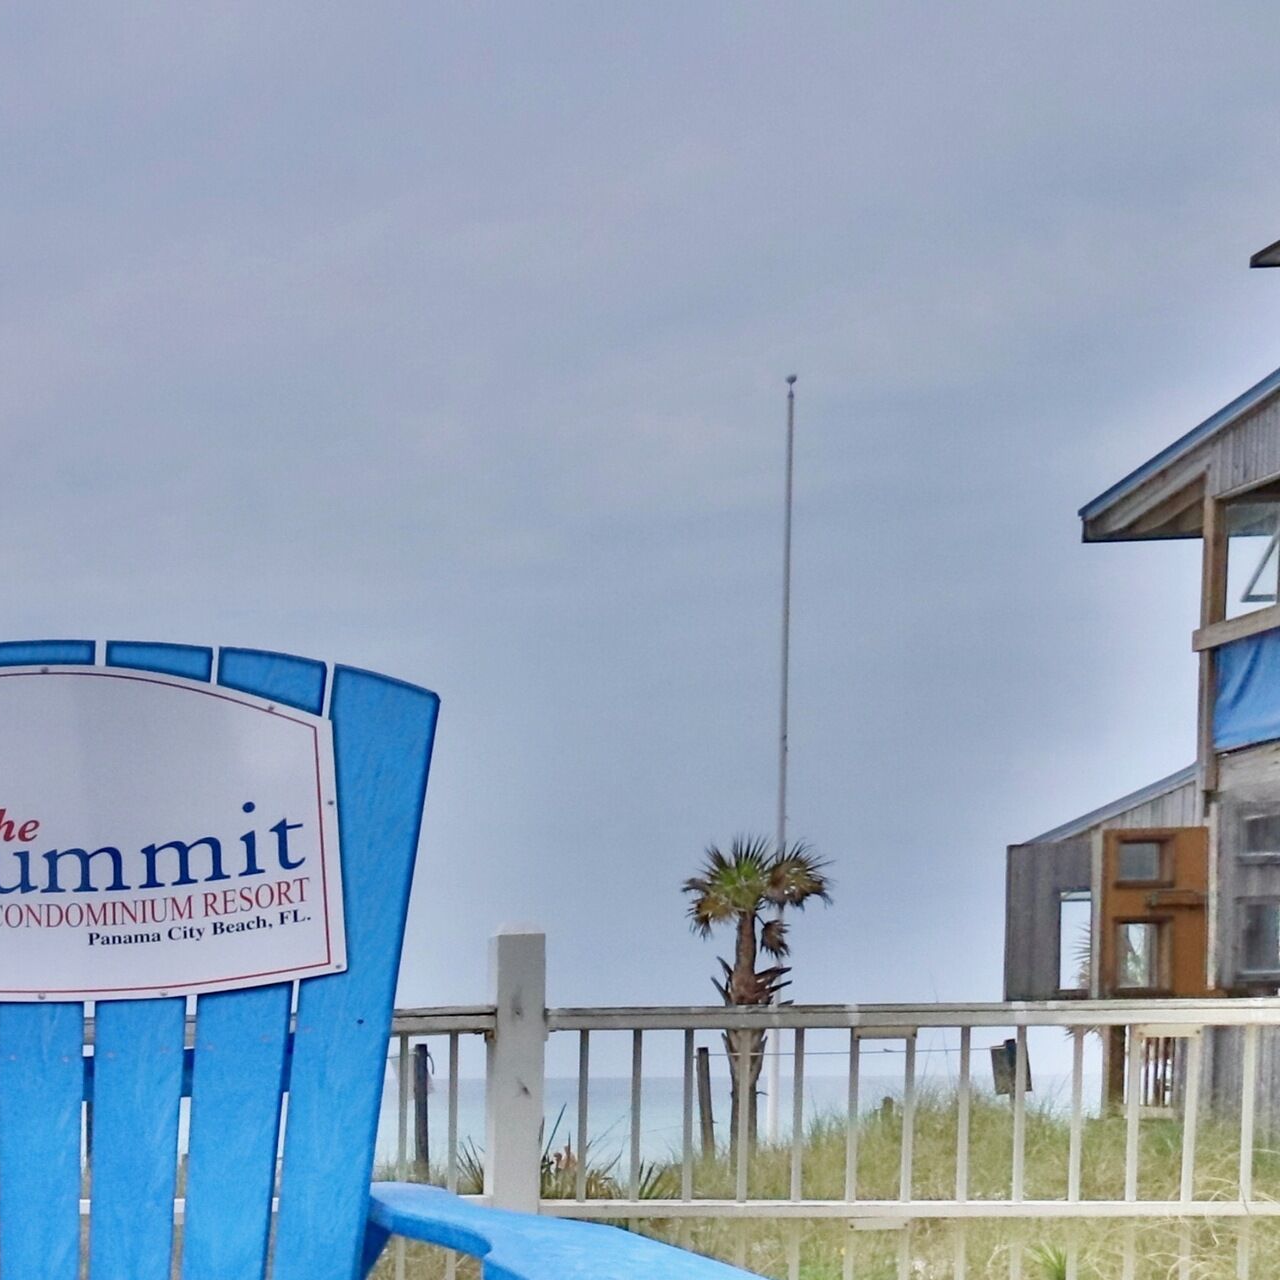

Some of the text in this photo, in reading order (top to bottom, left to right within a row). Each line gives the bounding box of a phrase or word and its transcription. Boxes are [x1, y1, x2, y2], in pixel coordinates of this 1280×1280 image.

[202, 877, 310, 917] RESORT
[87, 908, 312, 946] Panama City Beach, FL.
